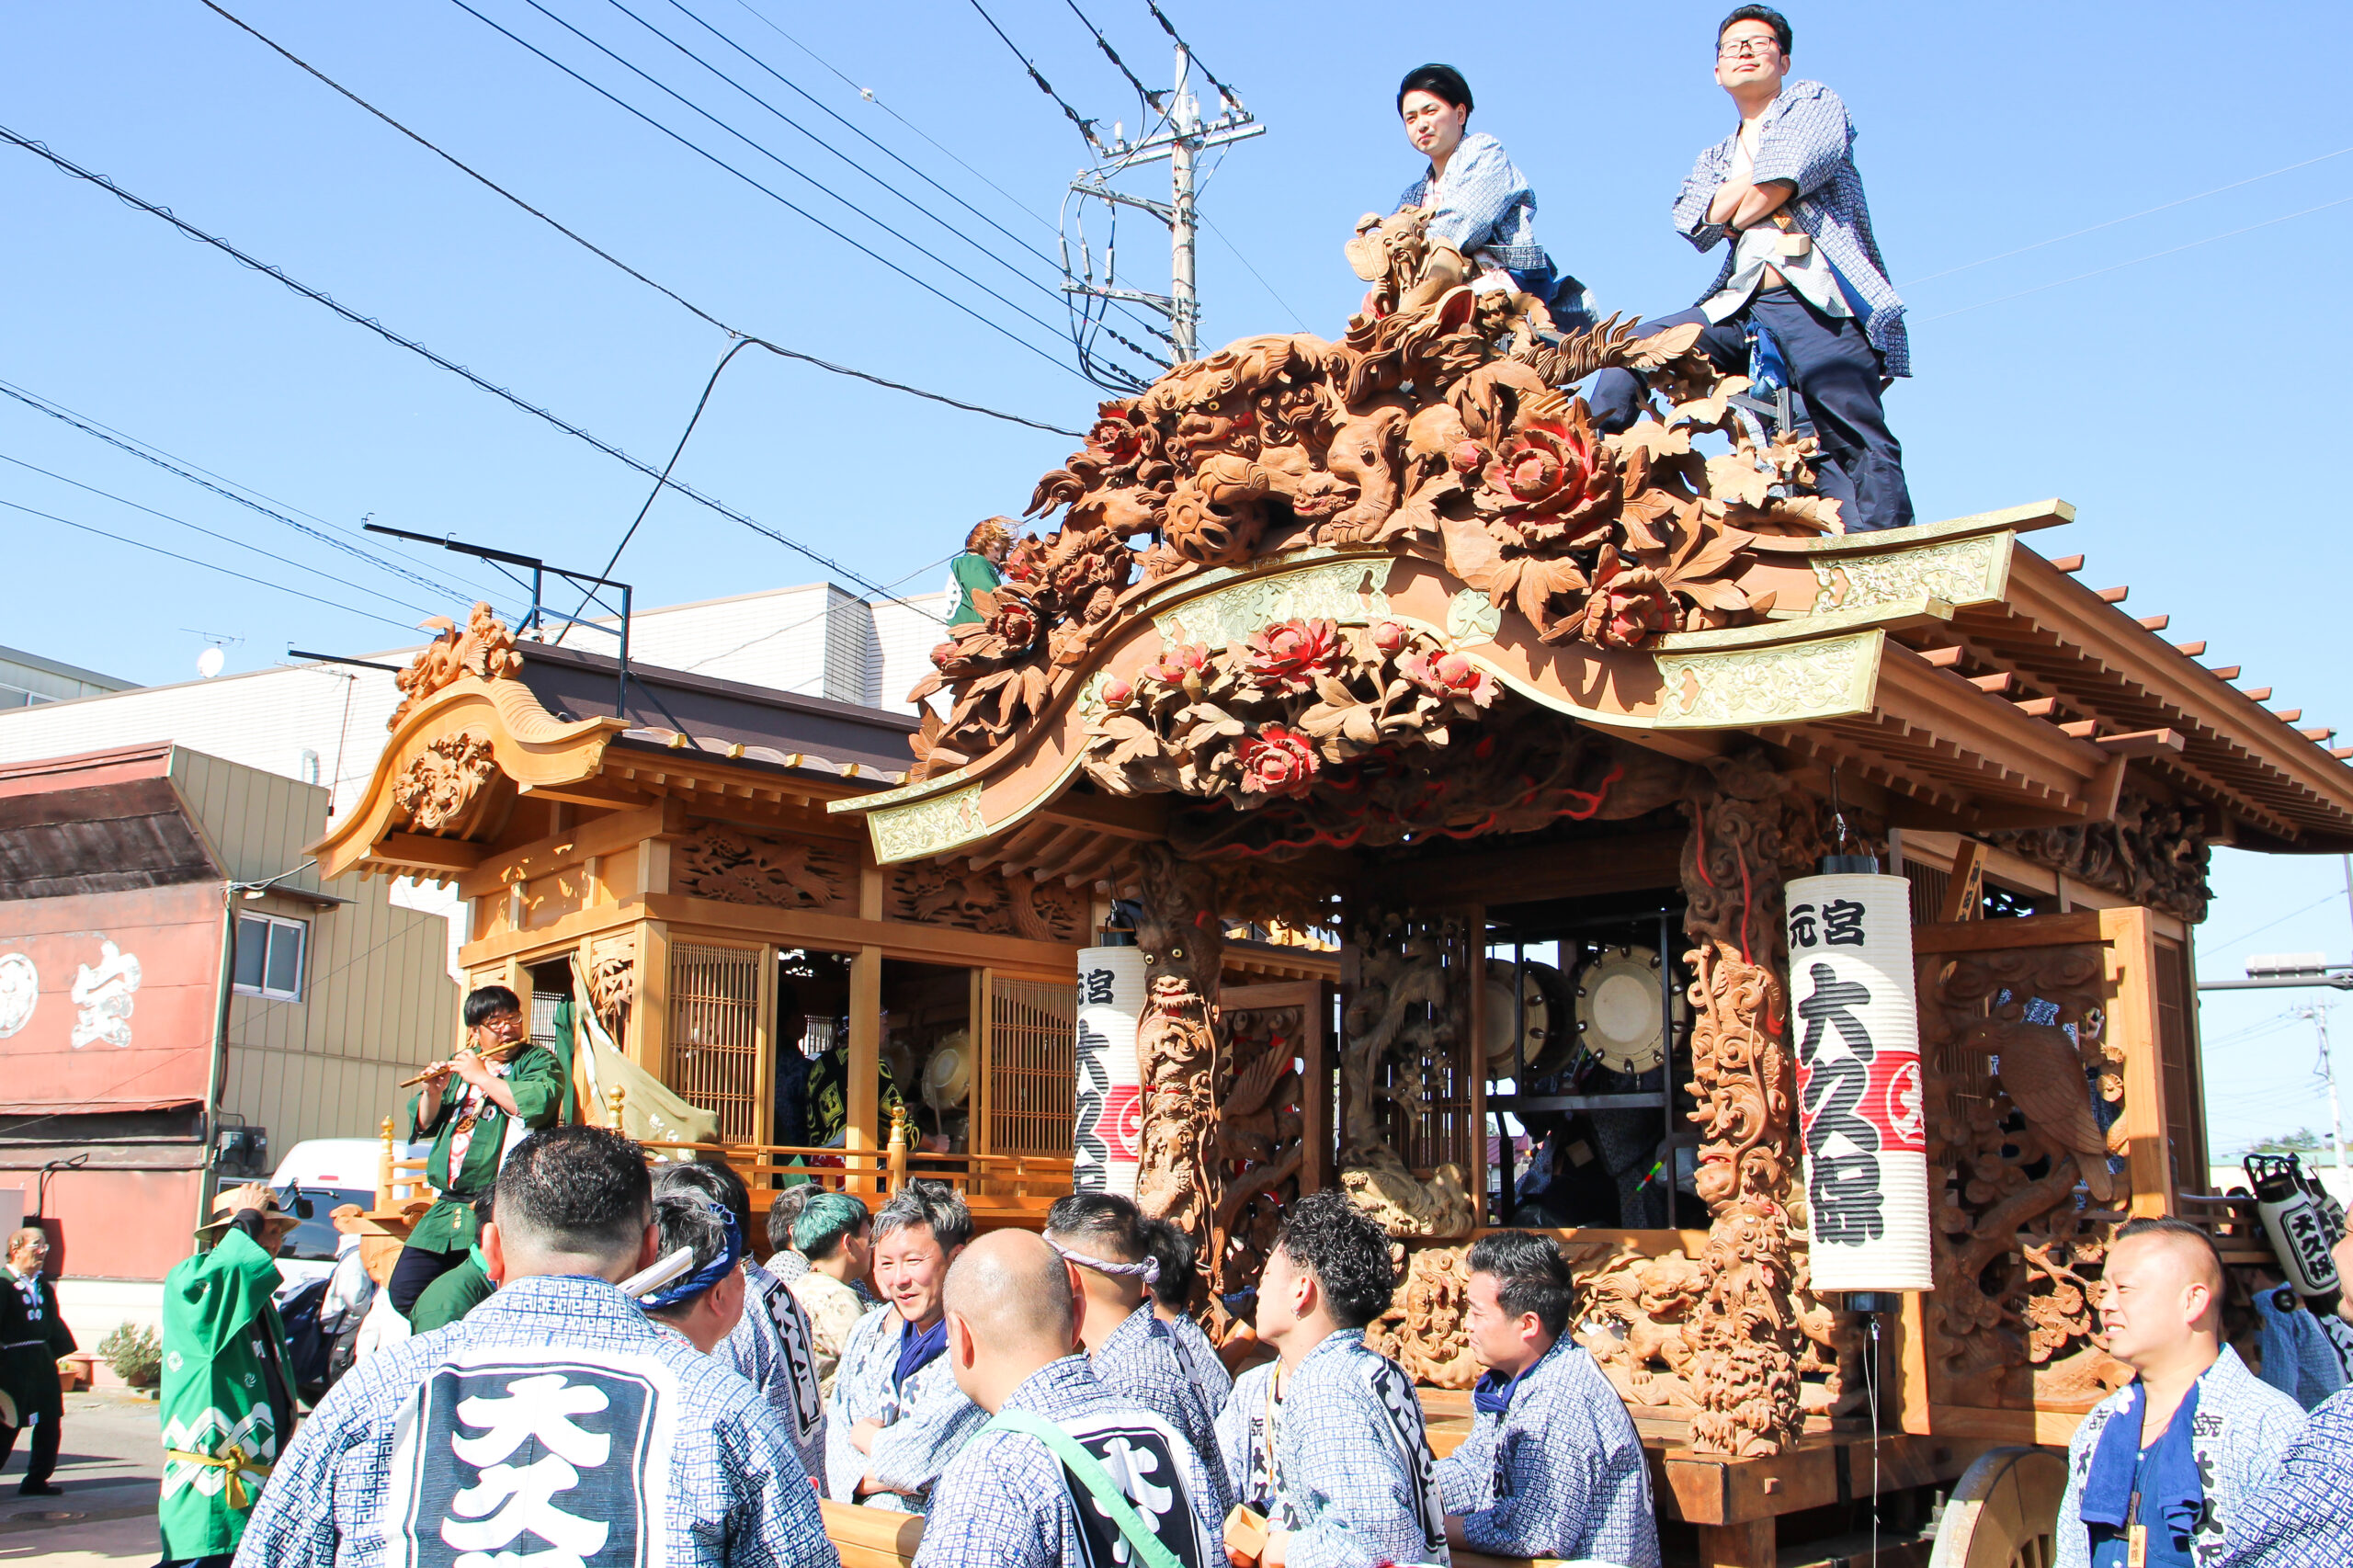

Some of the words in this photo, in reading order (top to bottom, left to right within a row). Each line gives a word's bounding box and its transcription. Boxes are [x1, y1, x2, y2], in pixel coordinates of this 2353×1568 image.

[1799, 962, 1884, 1247] 大久保
[2291, 1213, 2336, 1281] 大久保
[440, 1373, 611, 1568] 大久
